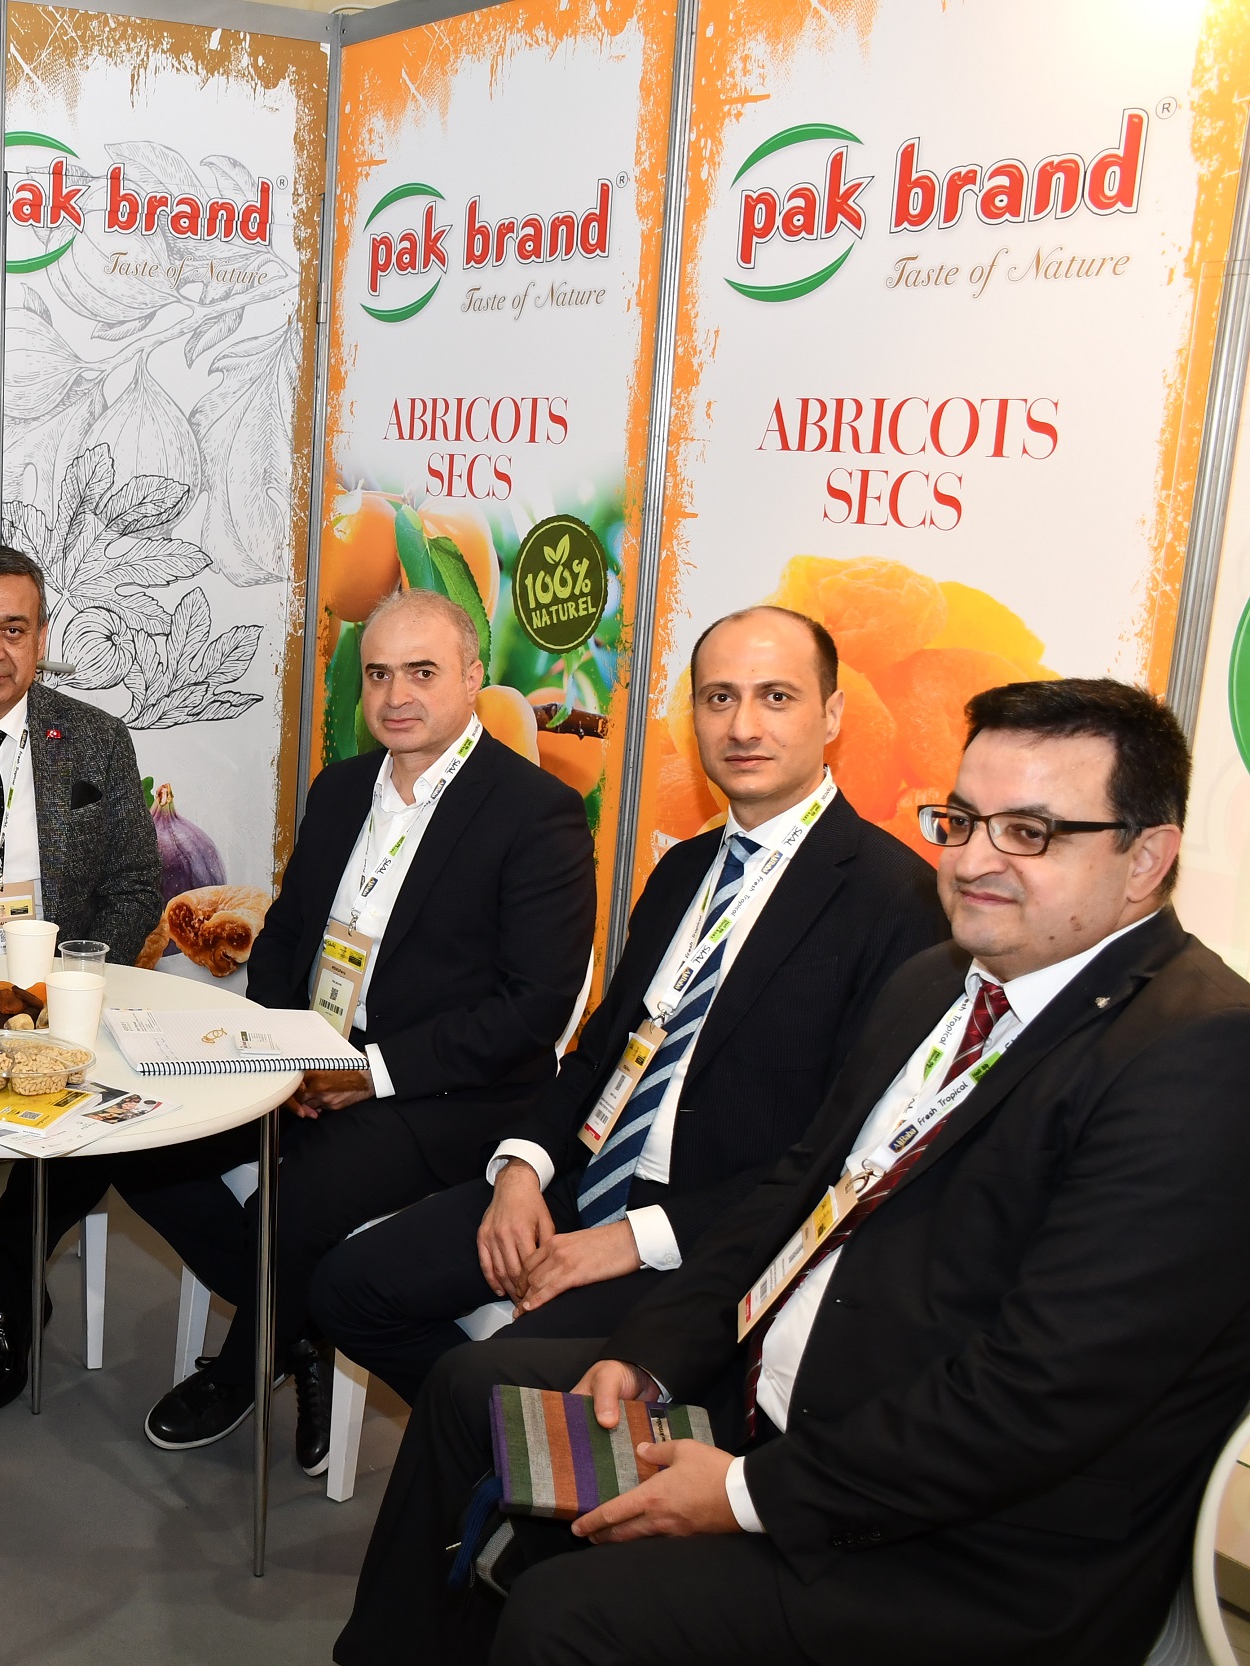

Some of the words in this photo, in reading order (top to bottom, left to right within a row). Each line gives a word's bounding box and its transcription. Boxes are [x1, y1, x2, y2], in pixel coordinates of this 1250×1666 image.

[104, 163, 273, 245] brand
[736, 145, 875, 269] pak
[889, 107, 1150, 234] brand
[367, 201, 453, 296] pak
[463, 178, 613, 270] brand
[104, 251, 162, 278] Taste
[165, 255, 193, 289] of
[193, 258, 268, 286] Nature
[885, 254, 959, 291] Taste
[969, 247, 1009, 299] of
[1007, 246, 1130, 282] Nature
[461, 286, 506, 313] Taste
[511, 281, 535, 321] of
[535, 281, 606, 309] Nature
[382, 396, 569, 444] ABRICOTS
[755, 396, 1059, 460] ABRICOTS
[425, 452, 513, 501] SECS
[823, 467, 963, 531] SECS
[525, 557, 591, 609] 100%
[531, 596, 597, 629] NATUREL
[731, 894, 751, 917] Tropical
[940, 1015, 962, 1046] Tropical
[938, 1081, 969, 1107] Tropical
